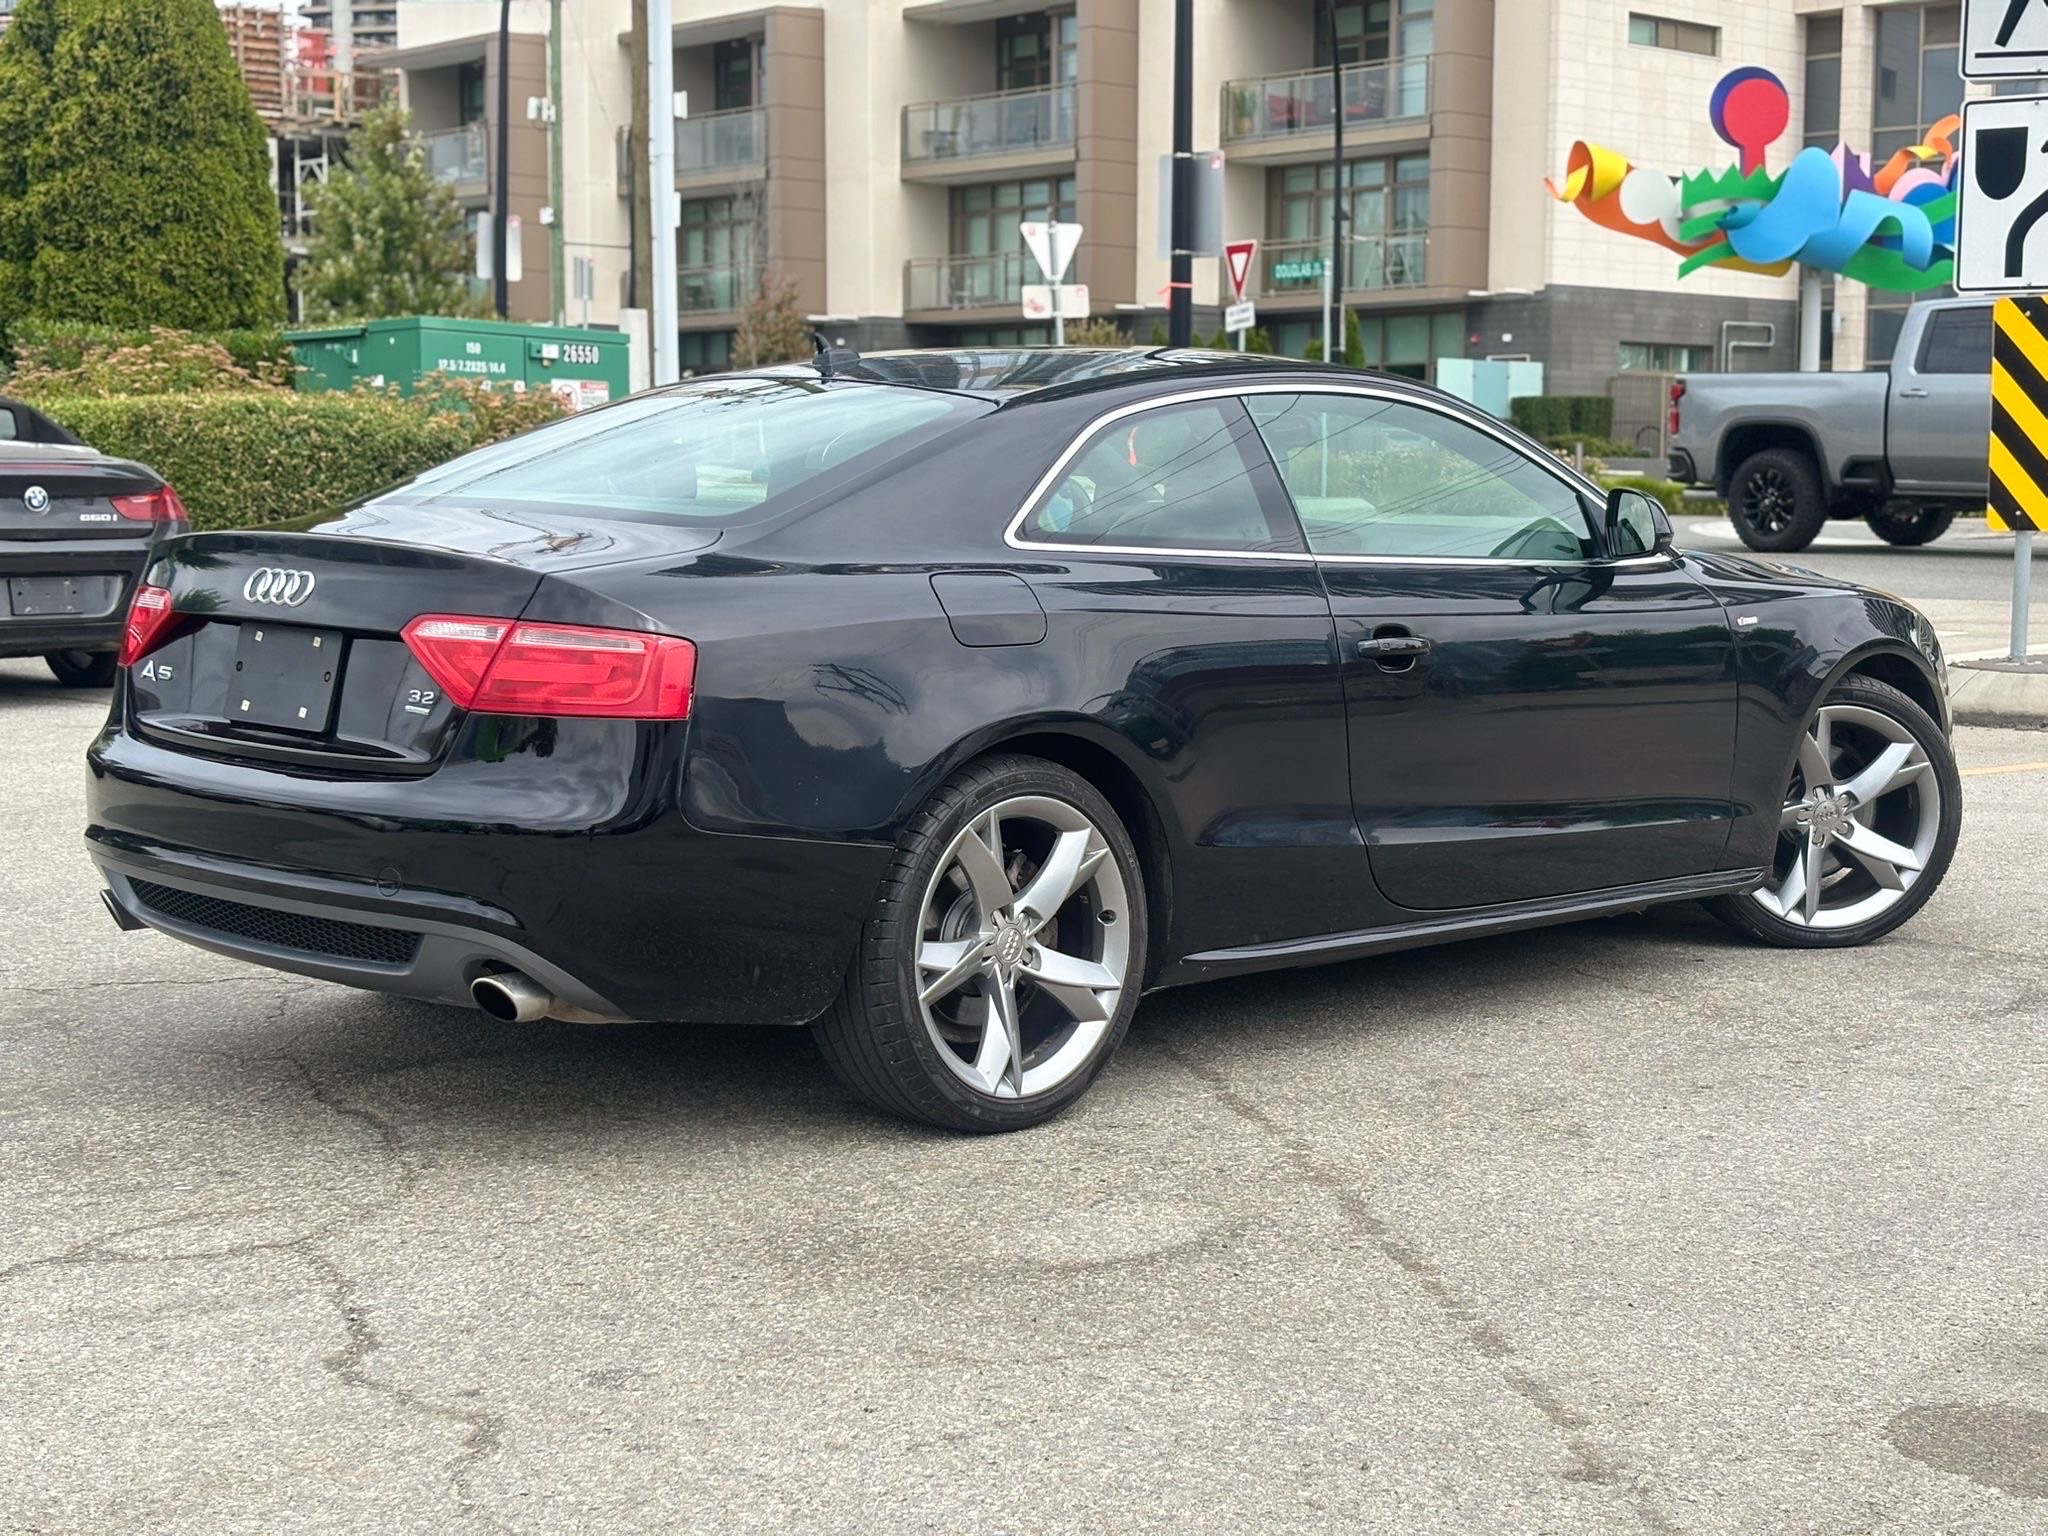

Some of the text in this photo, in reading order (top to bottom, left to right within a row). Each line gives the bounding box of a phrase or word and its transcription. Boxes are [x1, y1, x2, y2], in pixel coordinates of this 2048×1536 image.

[466, 342, 481, 355] 150
[563, 344, 599, 365] 26550
[140, 660, 173, 682] A5
